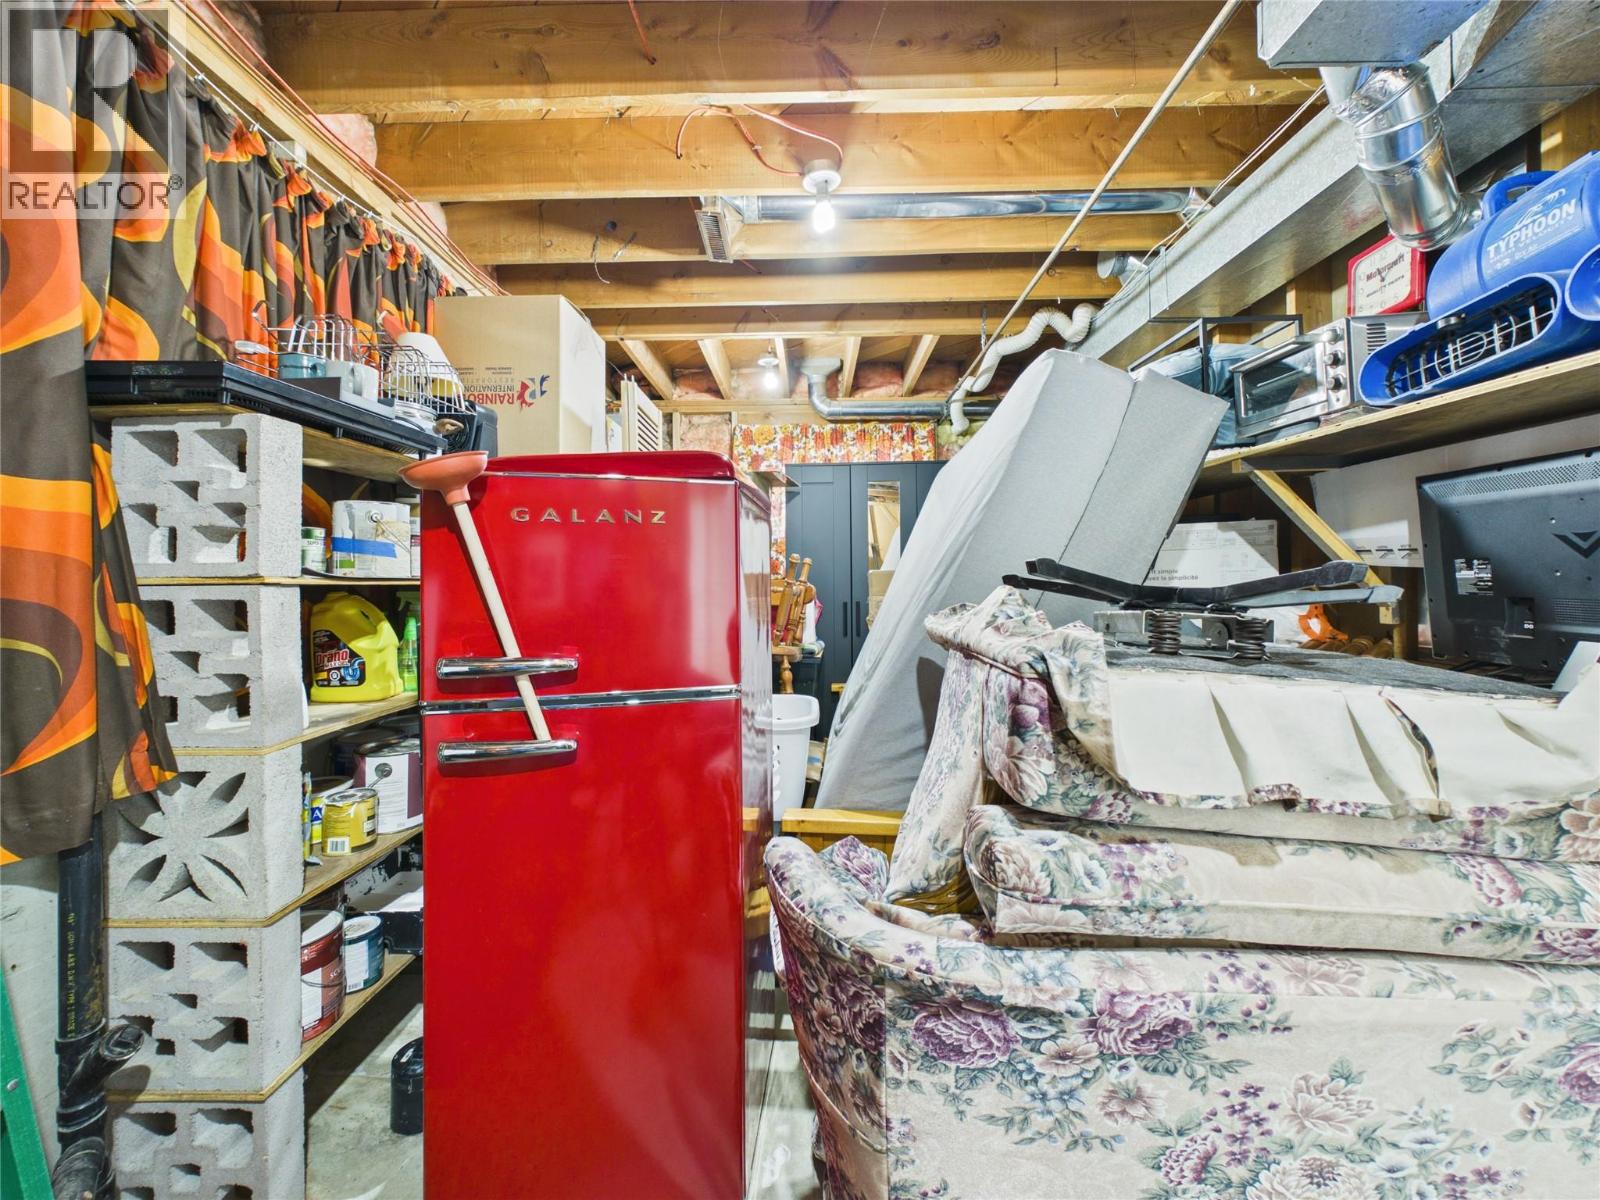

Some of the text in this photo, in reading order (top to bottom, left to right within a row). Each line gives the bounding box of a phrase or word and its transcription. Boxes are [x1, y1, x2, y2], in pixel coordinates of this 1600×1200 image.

[1486, 198, 1577, 259] TYPHOON
[510, 507, 667, 525] GALANZ
[314, 648, 350, 669] Drano
